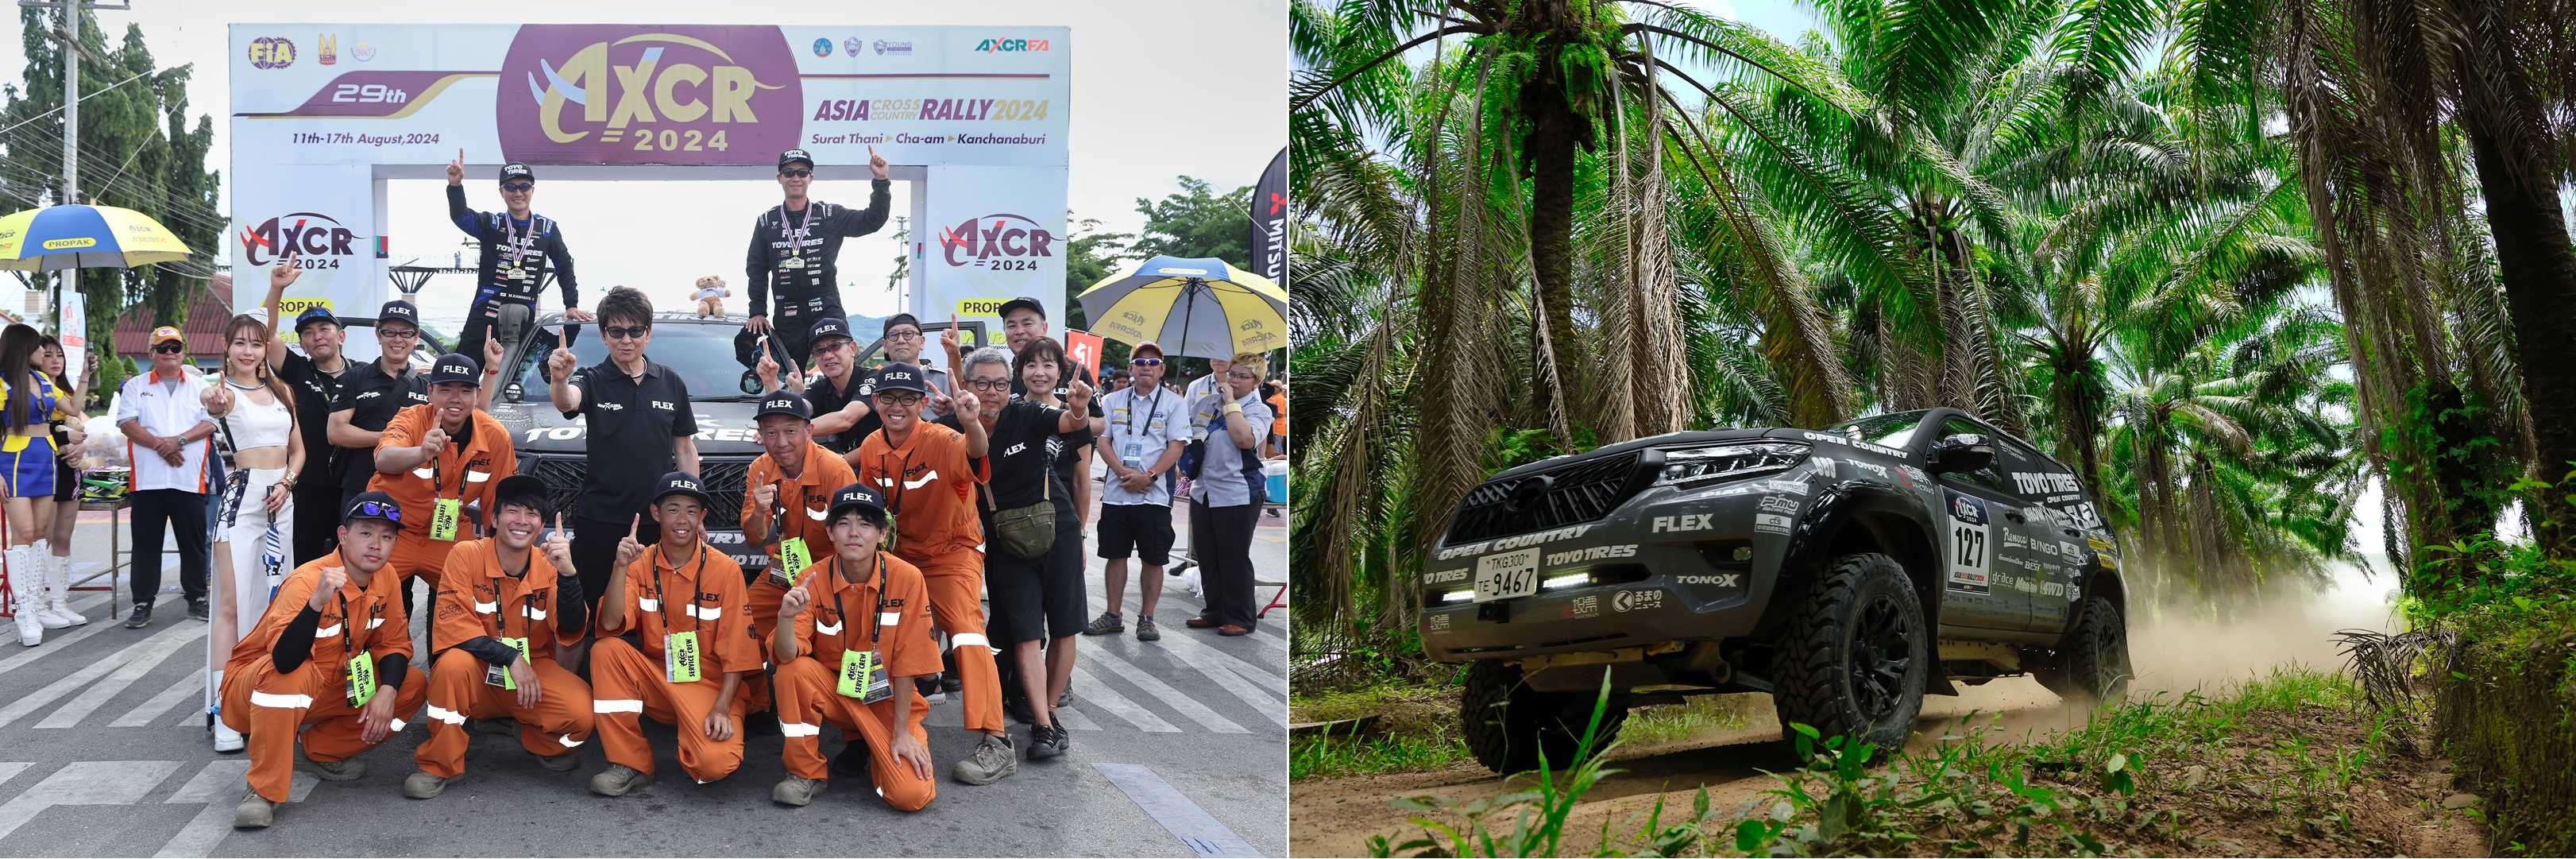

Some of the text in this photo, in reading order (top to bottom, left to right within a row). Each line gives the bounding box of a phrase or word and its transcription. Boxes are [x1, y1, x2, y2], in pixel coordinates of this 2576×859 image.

[974, 39, 1049, 52] AXCRFA
[332, 83, 406, 104] 29th
[527, 33, 759, 143] AXCR
[813, 99, 1049, 121] ASIA CROSS RALLY 2024
[870, 111, 918, 121] COUNTRY
[292, 132, 439, 147] 11th-17th August,2024
[633, 129, 728, 152] 2024
[812, 133, 1047, 145] Surat Thani Cha-am Kanchanaburi
[48, 240, 90, 249] PROPAK
[240, 213, 354, 266] AXCR
[939, 215, 1052, 266] AXCR
[293, 258, 340, 269] 2024
[991, 260, 1037, 271] 2024
[279, 300, 325, 312] ROPAK
[388, 307, 411, 315] FLEX
[963, 302, 999, 313] PROP
[815, 324, 837, 335] FLEX
[442, 366, 469, 376] FLEX
[884, 371, 912, 381] FLEX
[652, 400, 674, 411] FLEX
[766, 400, 793, 409] FLEX
[1803, 431, 1908, 459] OPEN COUNTRY
[671, 480, 698, 491] FLEX
[2012, 472, 2080, 494] TOYO TIRES
[843, 493, 873, 503] FLEX
[1652, 513, 1714, 533] FLEX
[1438, 524, 1590, 561] OPEN COUNTRY
[1956, 526, 1984, 568] 127
[2030, 537, 2058, 555] BINGO
[1492, 553, 1525, 571] TKG300
[1546, 544, 1639, 567] TOYO TIRES
[2025, 559, 2041, 571] BEST
[1434, 567, 1469, 584] TIRES
[1478, 567, 1534, 596] TE 9467
[1677, 574, 1740, 587] TONOX
[701, 592, 720, 602] LEX
[882, 598, 905, 607] FLEX
[855, 669, 864, 694] SERVICE
